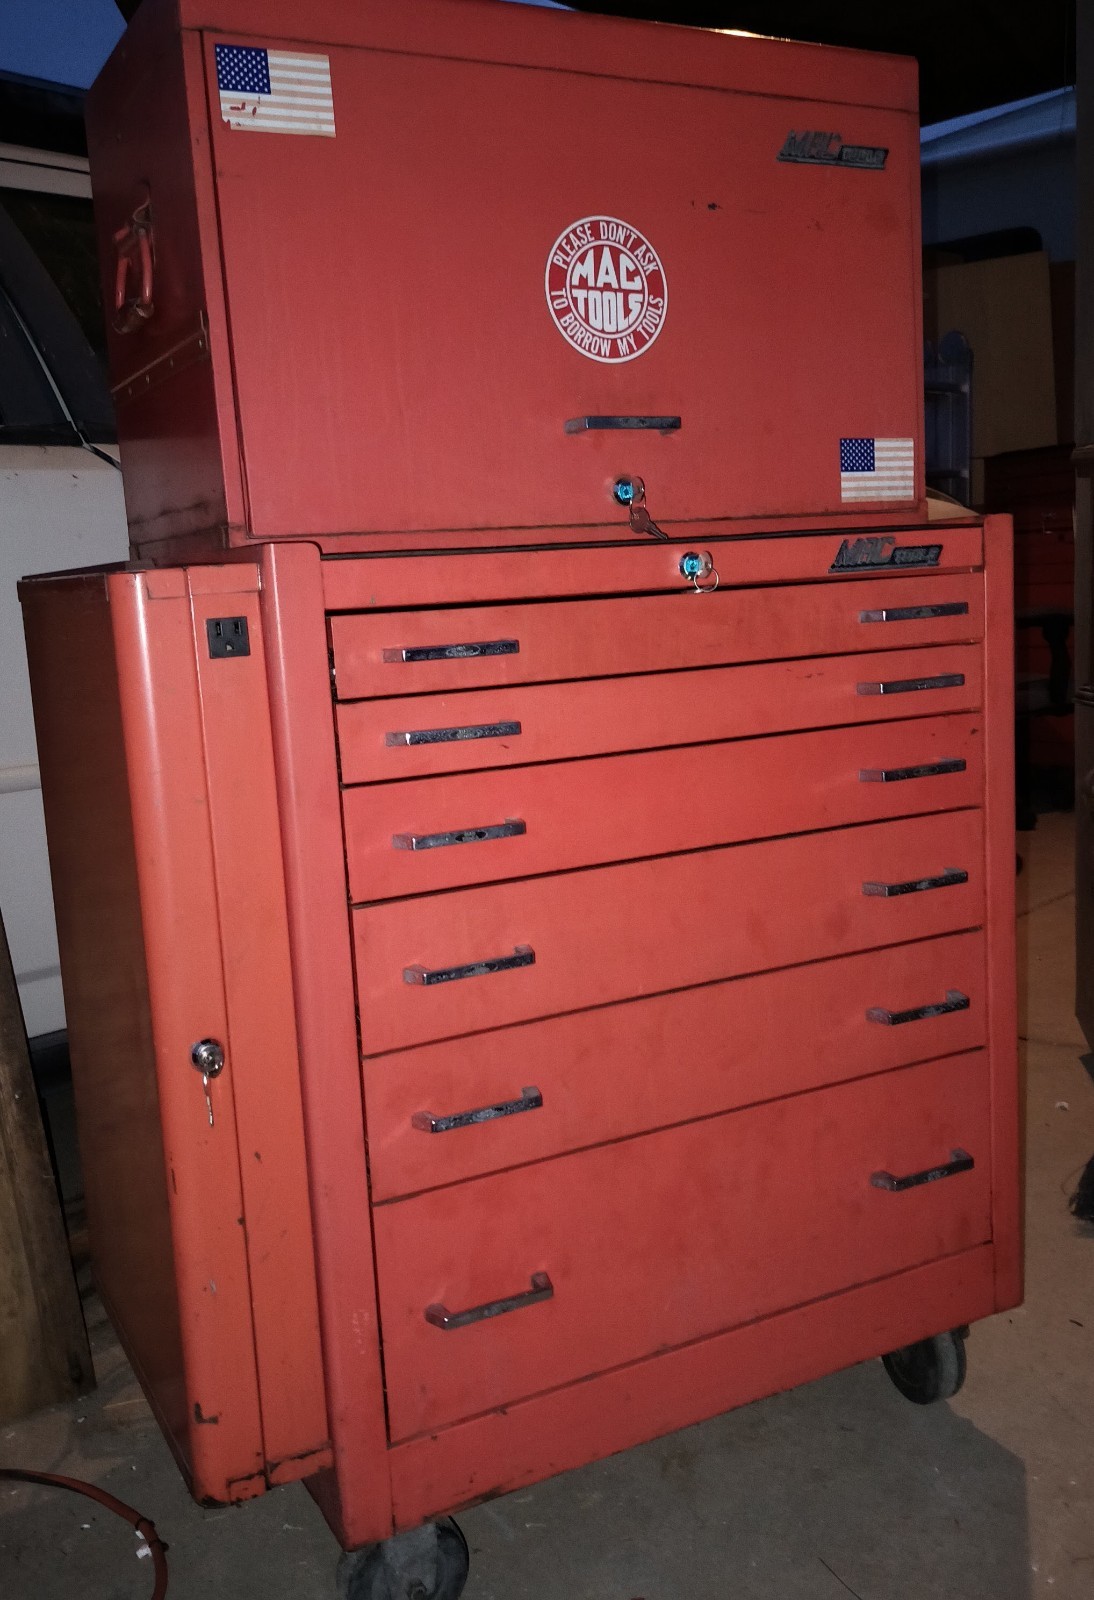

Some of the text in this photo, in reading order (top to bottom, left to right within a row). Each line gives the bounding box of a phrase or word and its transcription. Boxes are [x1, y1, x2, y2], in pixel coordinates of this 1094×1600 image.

[553, 221, 659, 276] PLEASE DON'T ASK
[572, 246, 642, 290] MAC
[550, 288, 664, 357] TO BORROW MY TOOLS
[572, 289, 643, 333] TOOLS
